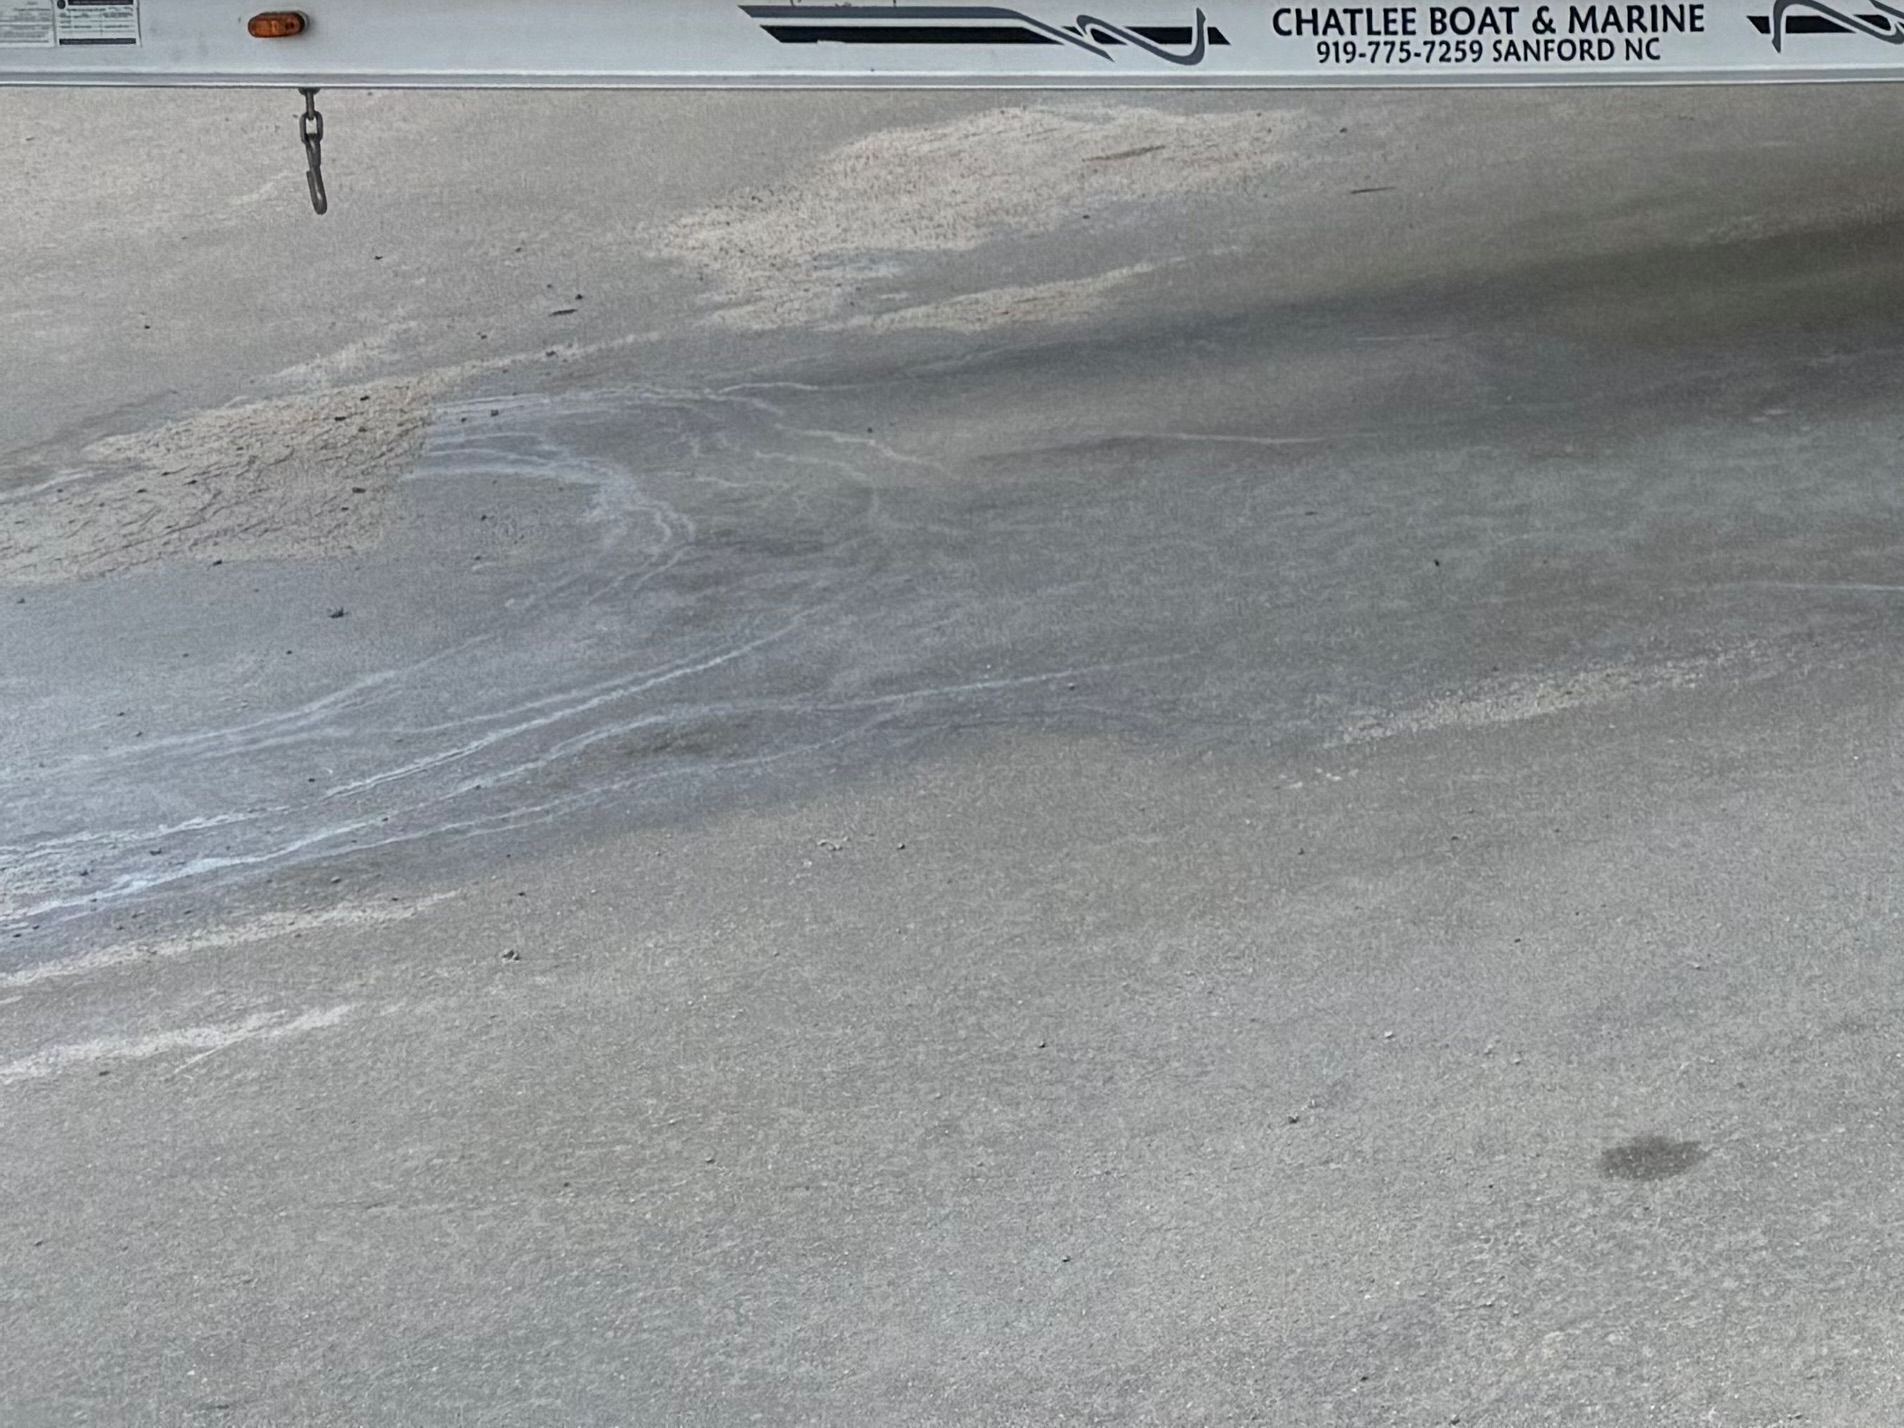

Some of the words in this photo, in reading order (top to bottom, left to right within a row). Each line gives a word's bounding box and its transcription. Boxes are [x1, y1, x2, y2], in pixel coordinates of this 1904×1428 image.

[1272, 7, 1417, 37] CHATLEE
[1429, 6, 1520, 36] BOAT
[1531, 5, 1556, 35] &
[1568, 3, 1705, 34] MARINE
[1316, 39, 1484, 64] 919-775-7259
[1492, 38, 1616, 62] SANFORD
[1624, 37, 1661, 61] NC
